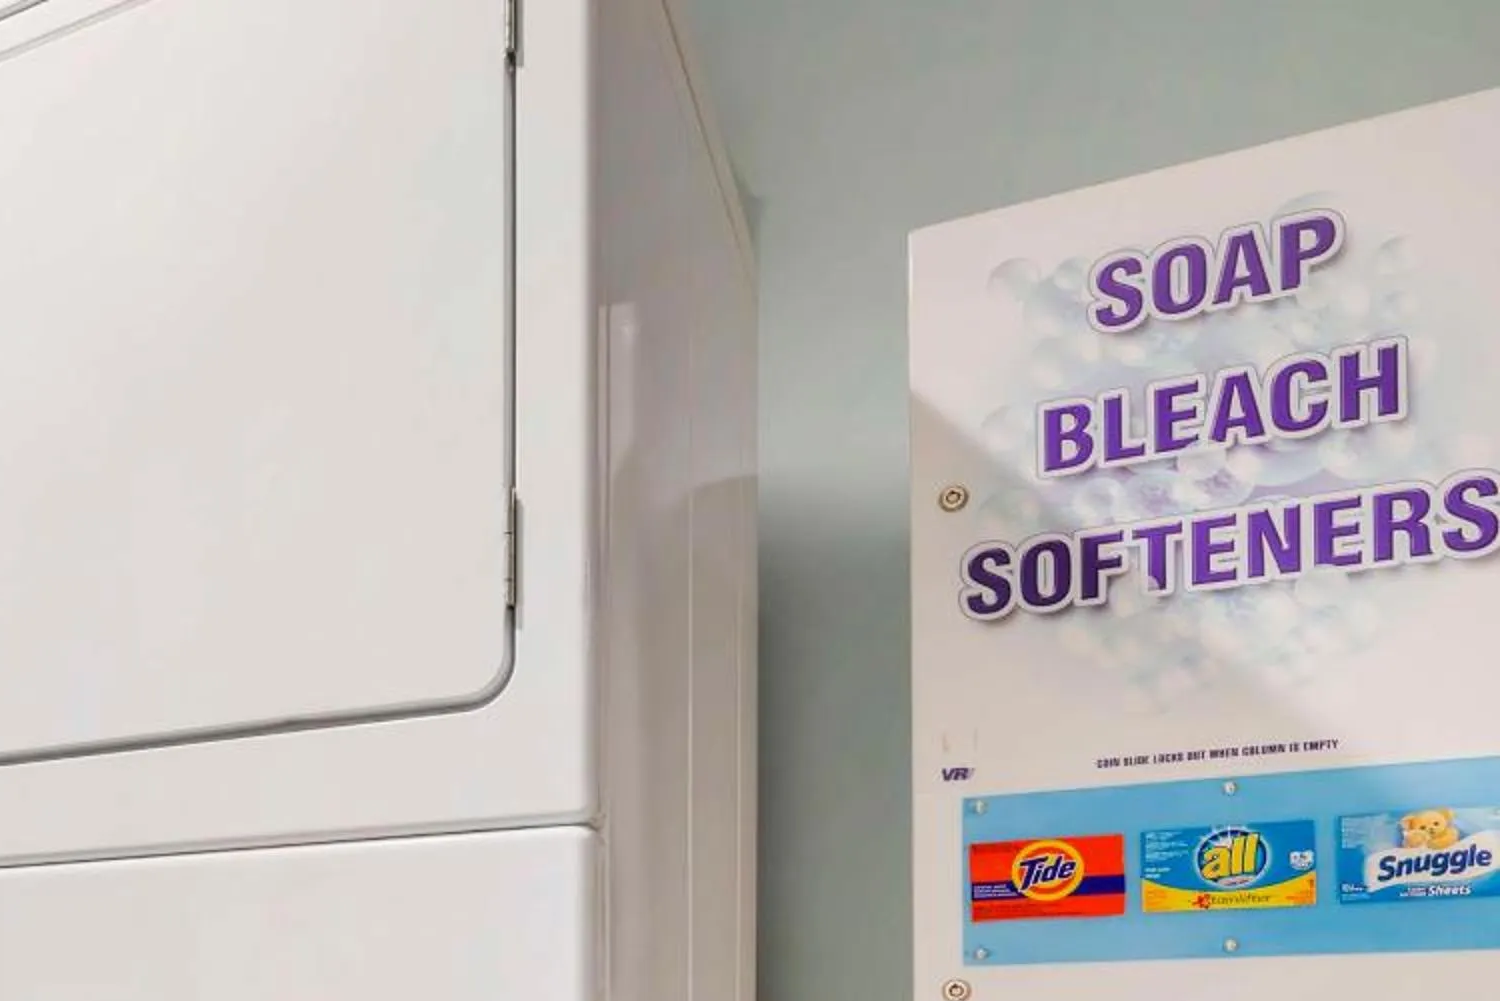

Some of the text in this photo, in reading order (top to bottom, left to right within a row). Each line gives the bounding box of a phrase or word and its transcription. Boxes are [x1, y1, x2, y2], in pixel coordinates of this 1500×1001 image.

[1092, 212, 1340, 330] SOAP
[1041, 341, 1402, 475] BLEACH
[964, 474, 1500, 617] SOFTENERS
[1208, 747, 1239, 759] WHEN
[1241, 743, 1285, 756] COLUMN
[1289, 742, 1299, 752] IS
[1303, 739, 1339, 751] EMPTY
[1018, 854, 1077, 891] Tide
[1202, 832, 1260, 881] all
[1377, 843, 1493, 882] Snuggle
